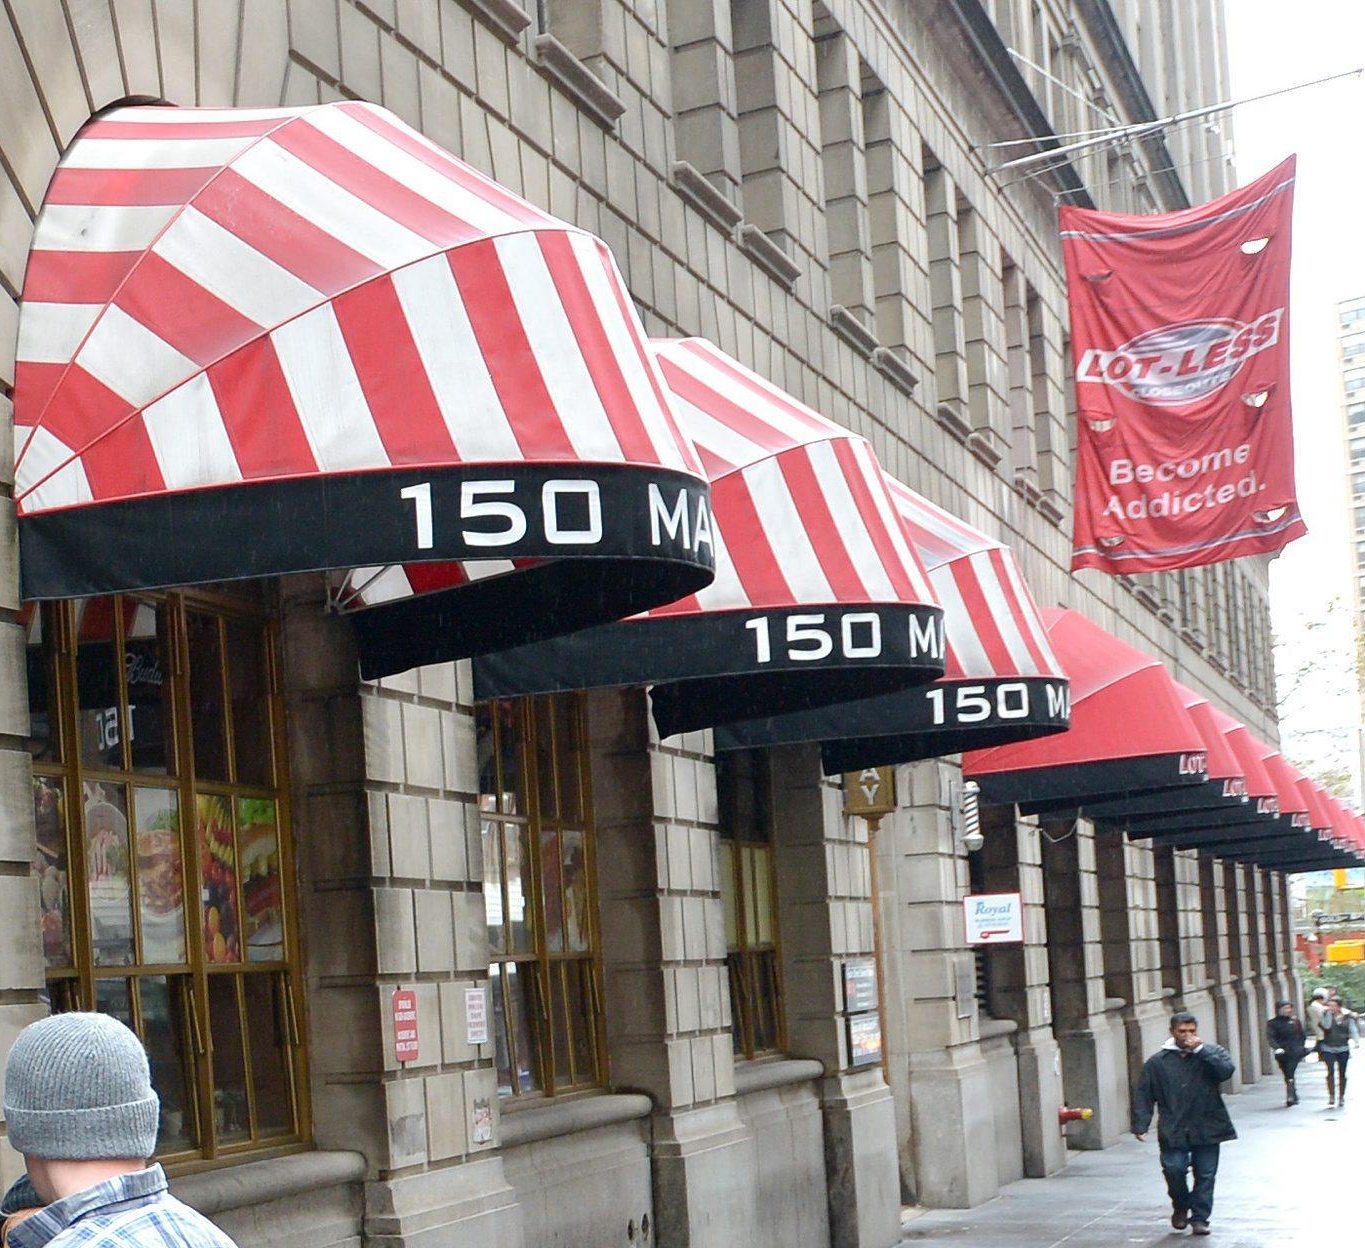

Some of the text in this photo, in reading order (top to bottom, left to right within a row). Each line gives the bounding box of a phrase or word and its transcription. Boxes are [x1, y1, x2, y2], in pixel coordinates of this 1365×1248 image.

[1085, 315, 1278, 380] LOT-LESS
[1108, 443, 1251, 486] Become
[400, 479, 603, 549] 150
[1102, 470, 1267, 522] Addicted.
[745, 612, 882, 663] 150
[926, 683, 1029, 725] 150
[974, 901, 1012, 916] Royal
